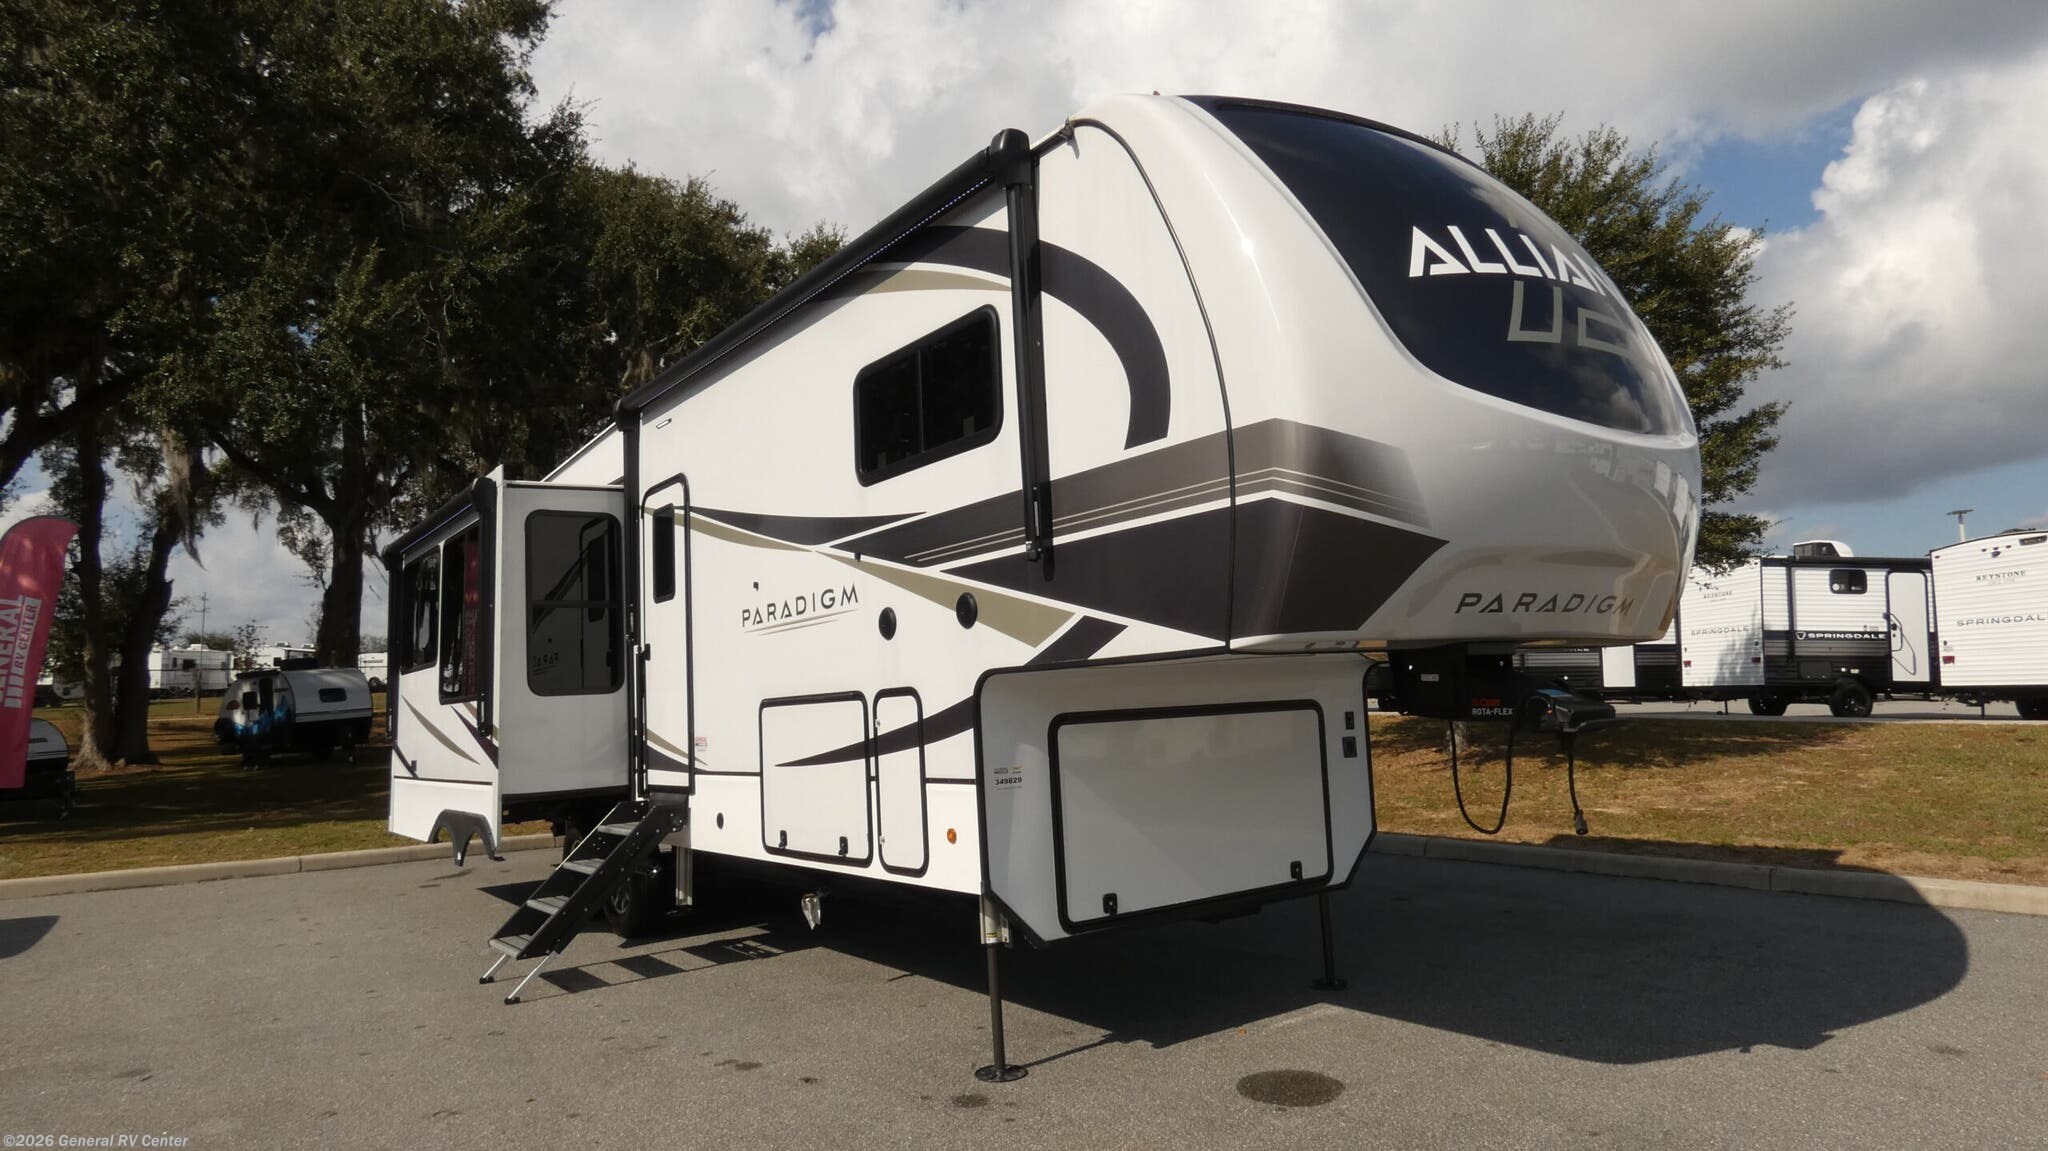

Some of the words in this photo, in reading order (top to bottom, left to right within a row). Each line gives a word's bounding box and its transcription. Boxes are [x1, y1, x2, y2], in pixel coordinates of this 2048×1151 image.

[742, 584, 858, 628] PARADIGM
[1455, 592, 1633, 616] PARADIGM
[18, 604, 38, 649] CENTER
[14, 652, 24, 669] RV
[1472, 707, 1513, 716] ROTA-FLEX
